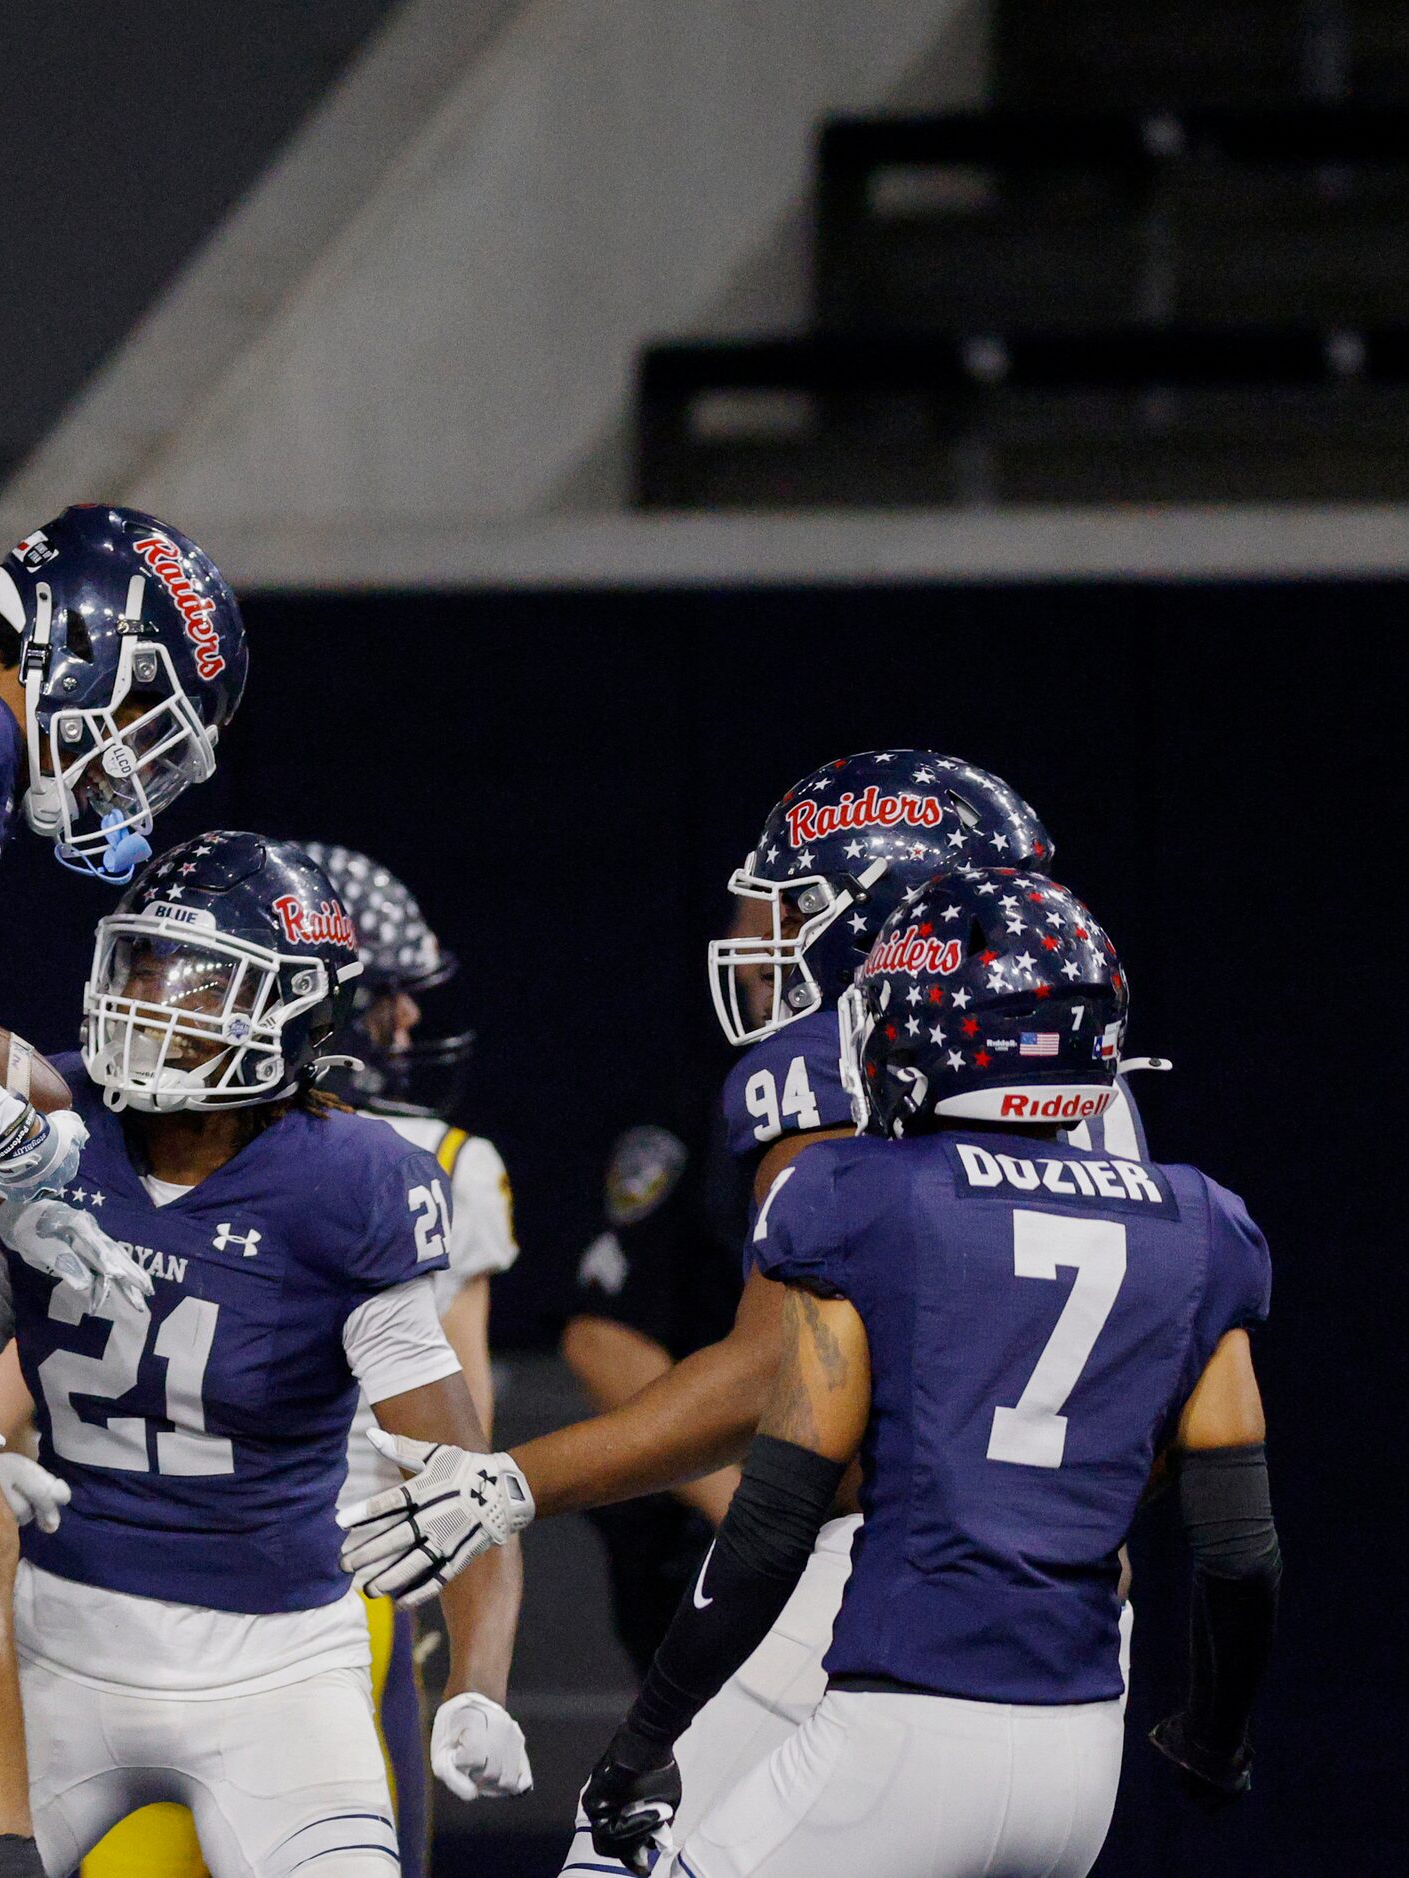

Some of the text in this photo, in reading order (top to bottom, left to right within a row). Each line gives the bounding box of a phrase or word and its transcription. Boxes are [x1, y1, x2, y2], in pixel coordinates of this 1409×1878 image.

[133, 537, 225, 681] Raiders
[113, 747, 131, 774] LLCD
[786, 786, 942, 847] Raiders
[155, 905, 198, 924] BLUE
[1071, 1005, 1085, 1031] 7
[745, 1056, 821, 1142] 94
[1001, 1093, 1110, 1117] Riddell
[955, 1143, 1163, 1203] DOZIER
[408, 1178, 452, 1263] 21
[986, 1209, 1127, 1469] 7
[37, 1270, 235, 1477] 21
